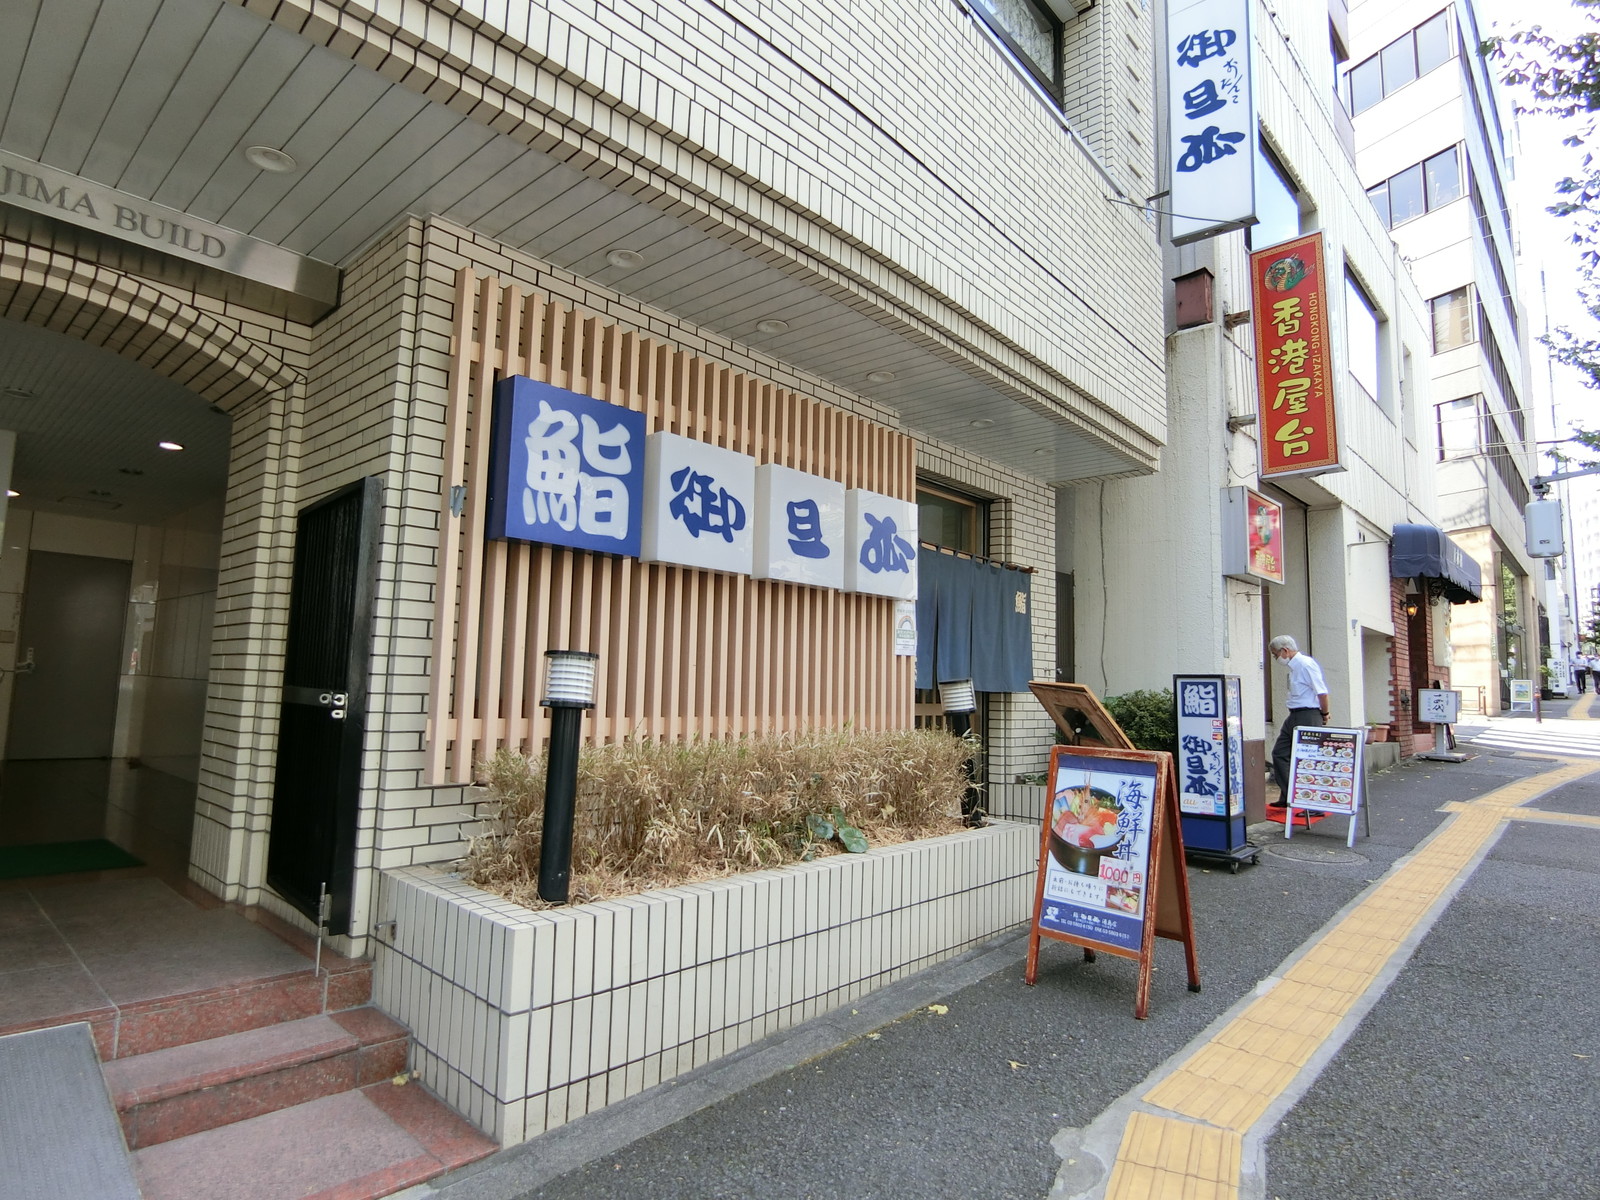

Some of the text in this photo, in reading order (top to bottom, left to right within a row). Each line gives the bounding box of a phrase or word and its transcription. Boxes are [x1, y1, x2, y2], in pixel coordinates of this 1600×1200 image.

[112, 202, 227, 260] BUILD
[1271, 297, 1315, 458] 香港屋台
[523, 400, 633, 541] 鮨
[1184, 684, 1216, 715] 鮨
[1114, 779, 1146, 862] 海鮮丼
